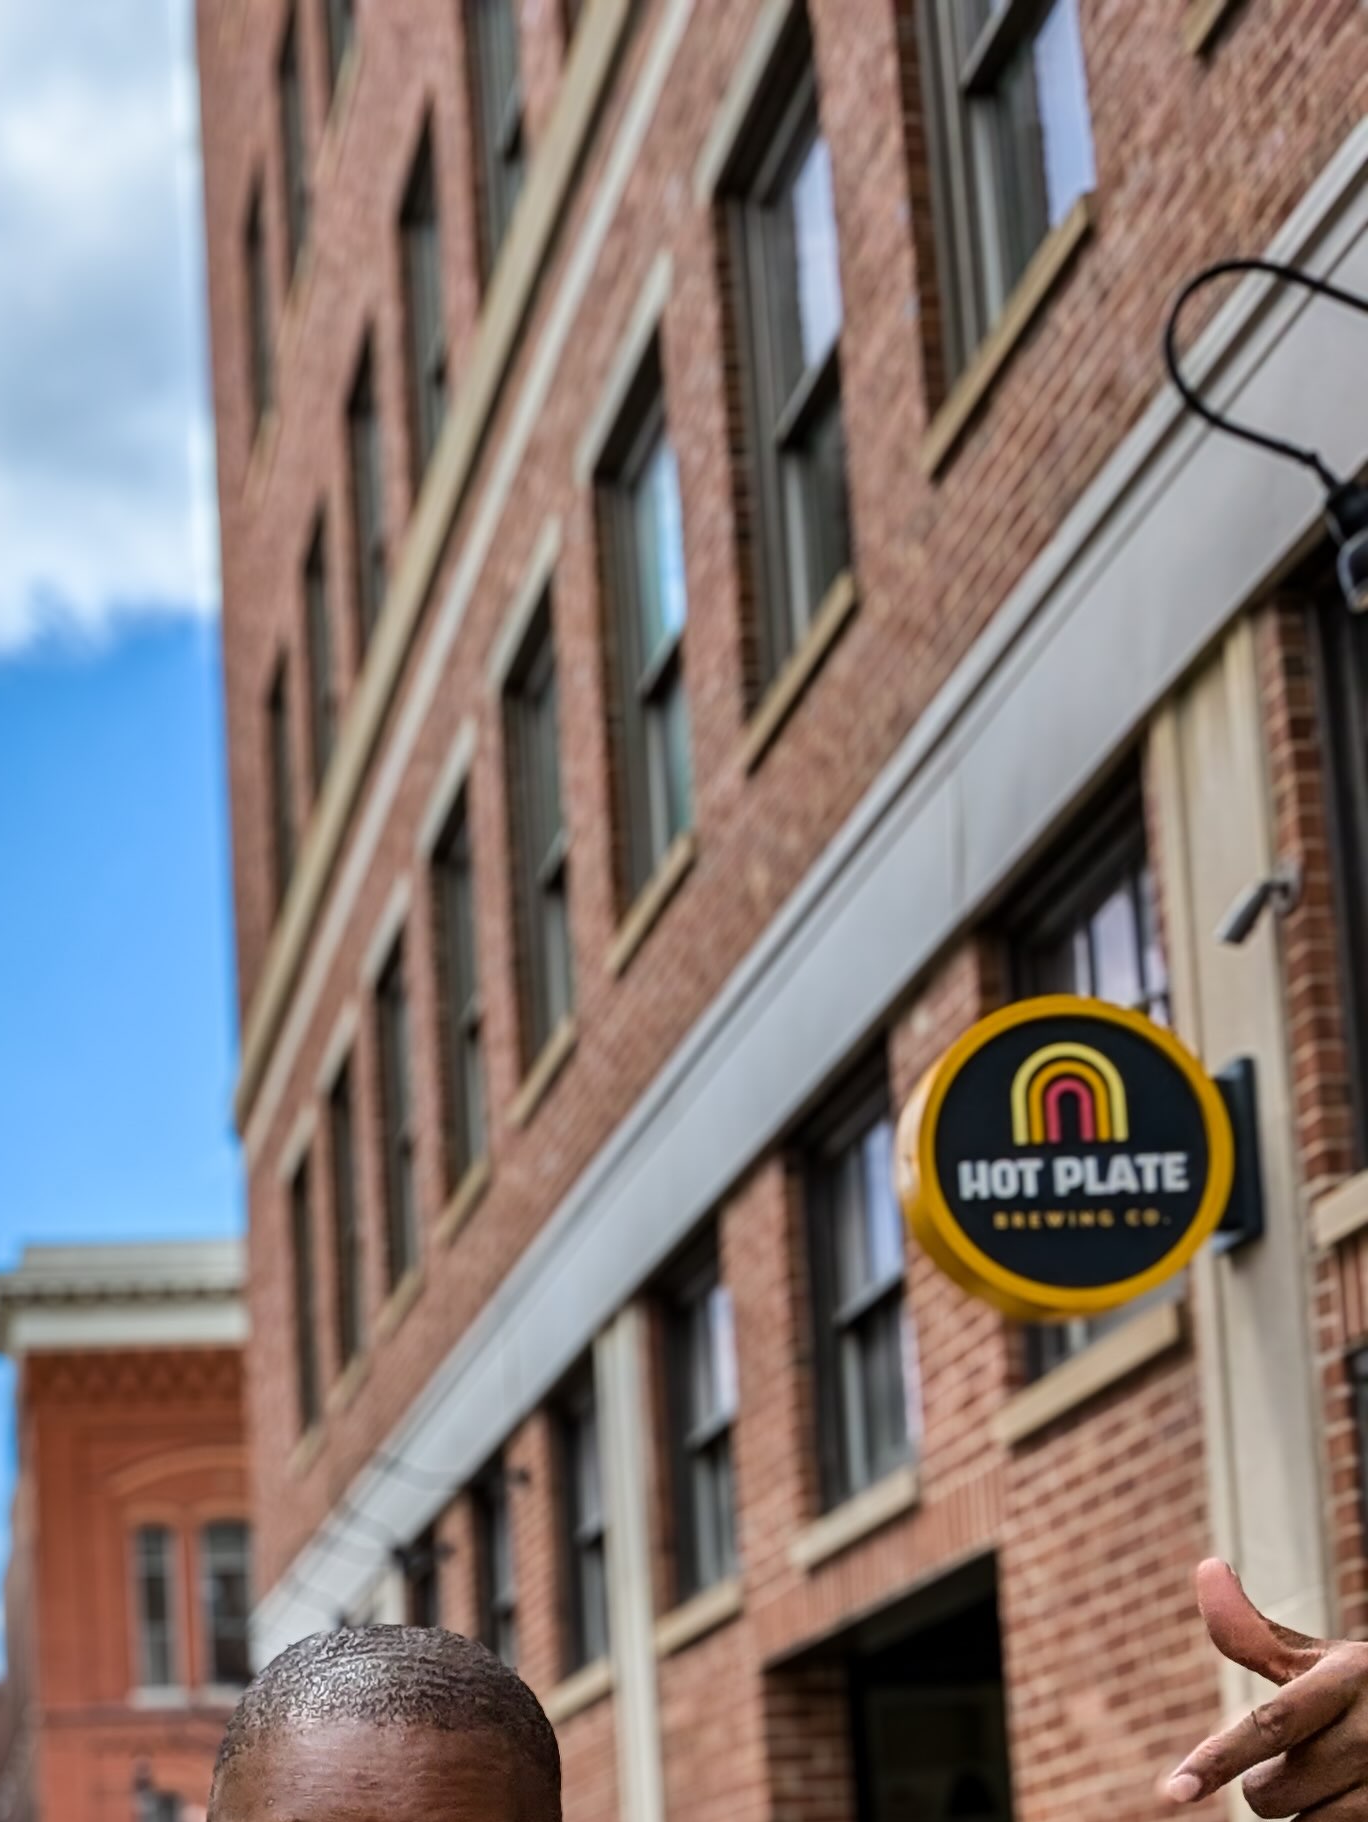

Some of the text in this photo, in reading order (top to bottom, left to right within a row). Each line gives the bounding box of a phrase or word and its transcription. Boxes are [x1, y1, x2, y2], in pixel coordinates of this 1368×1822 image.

[957, 1152, 1190, 1201] HOT PLATE
[992, 1207, 1172, 1231] BREWING CO.
